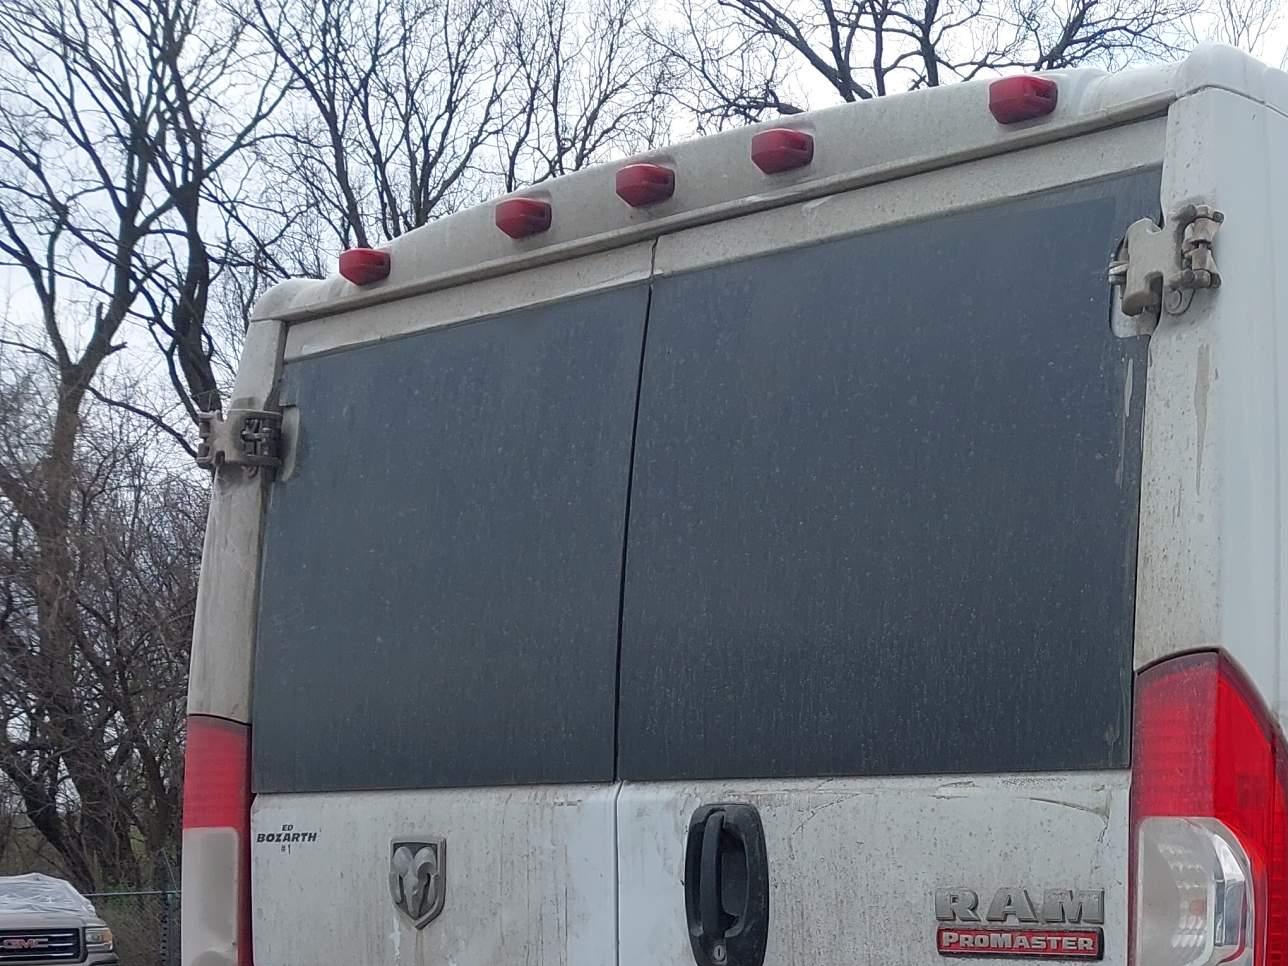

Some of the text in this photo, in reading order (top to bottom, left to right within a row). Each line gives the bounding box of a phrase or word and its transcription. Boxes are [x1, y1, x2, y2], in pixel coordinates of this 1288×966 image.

[281, 824, 294, 832] ED
[256, 832, 317, 843] BOZARTH
[934, 886, 1105, 924] RAM
[942, 932, 1094, 951] PROMASTER
